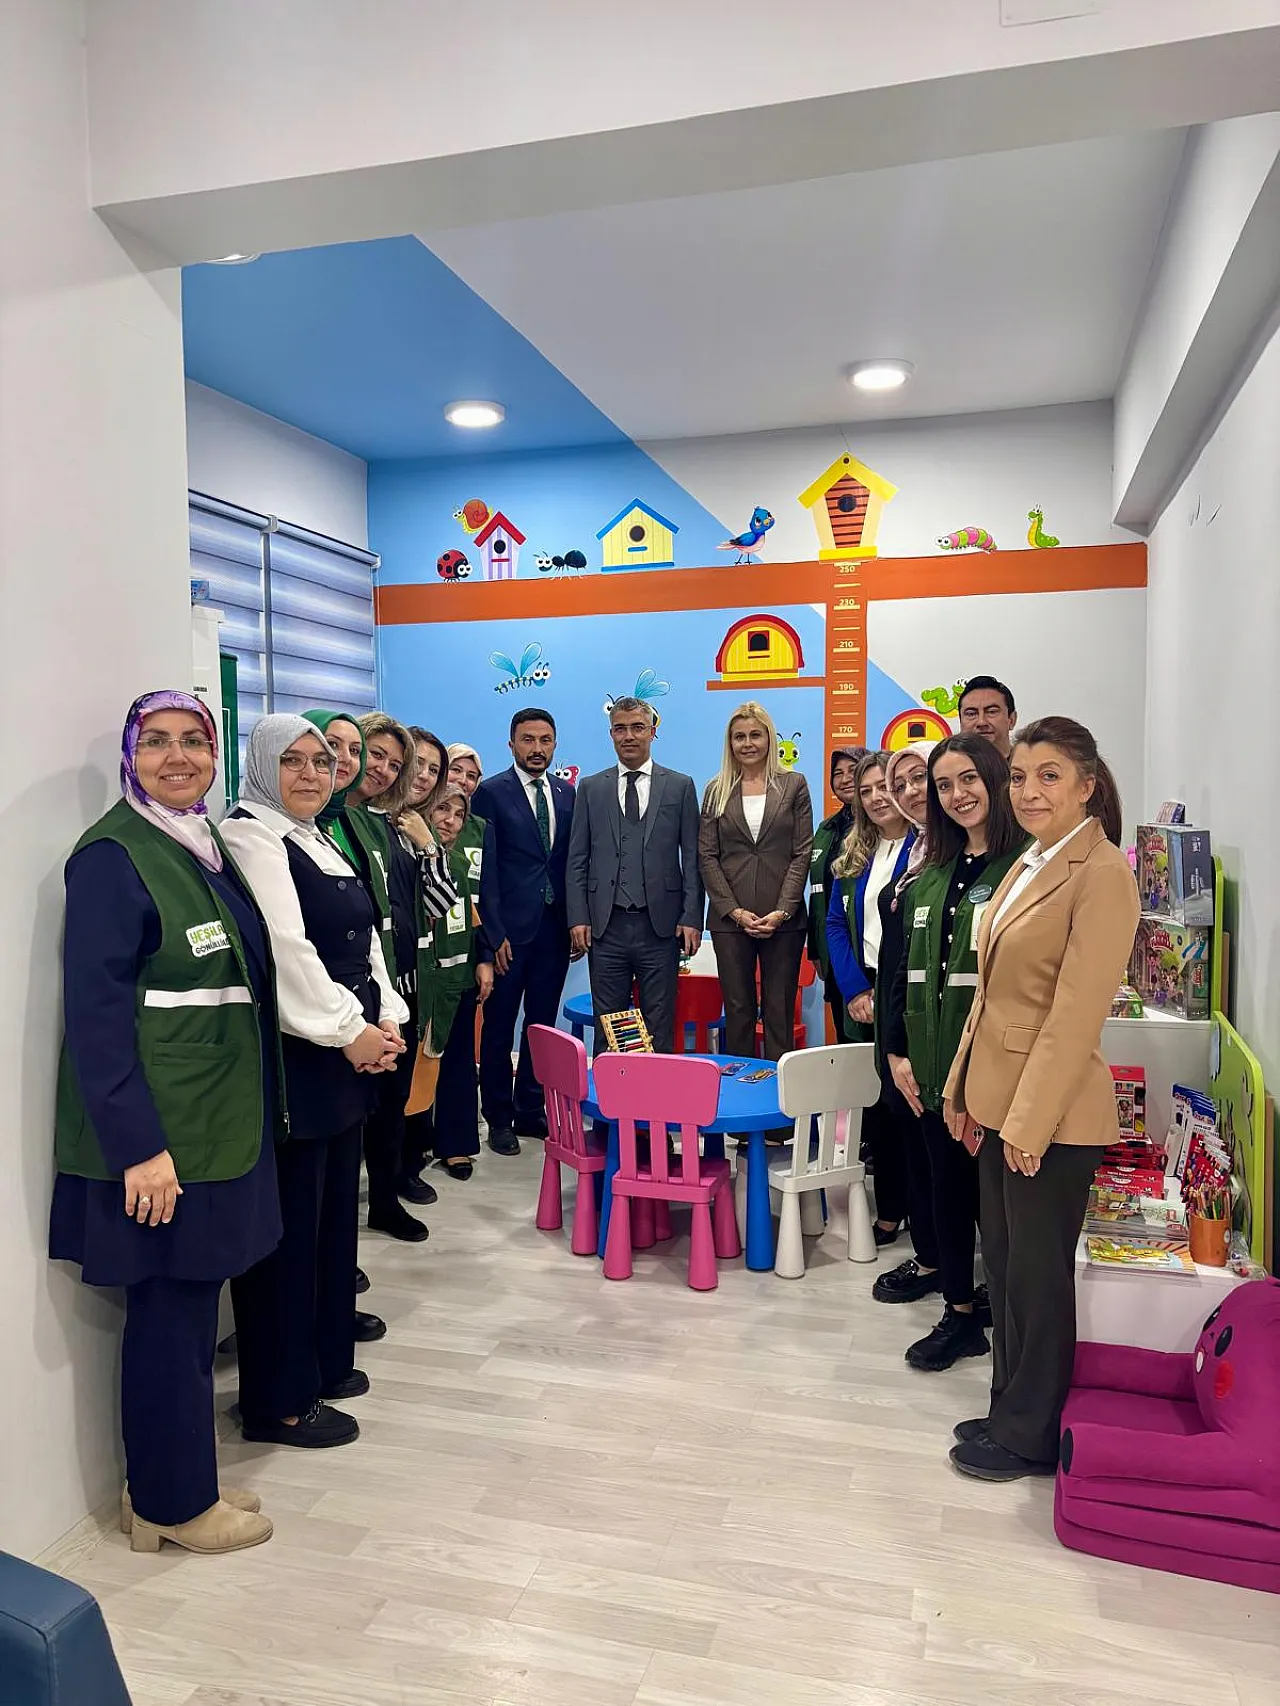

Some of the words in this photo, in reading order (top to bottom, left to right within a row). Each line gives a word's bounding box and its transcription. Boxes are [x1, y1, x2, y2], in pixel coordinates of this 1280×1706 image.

[839, 565, 855, 573] 250
[839, 598, 855, 606] 230
[839, 640, 854, 648] 210
[839, 683, 854, 691] 190
[838, 725, 853, 734] 170
